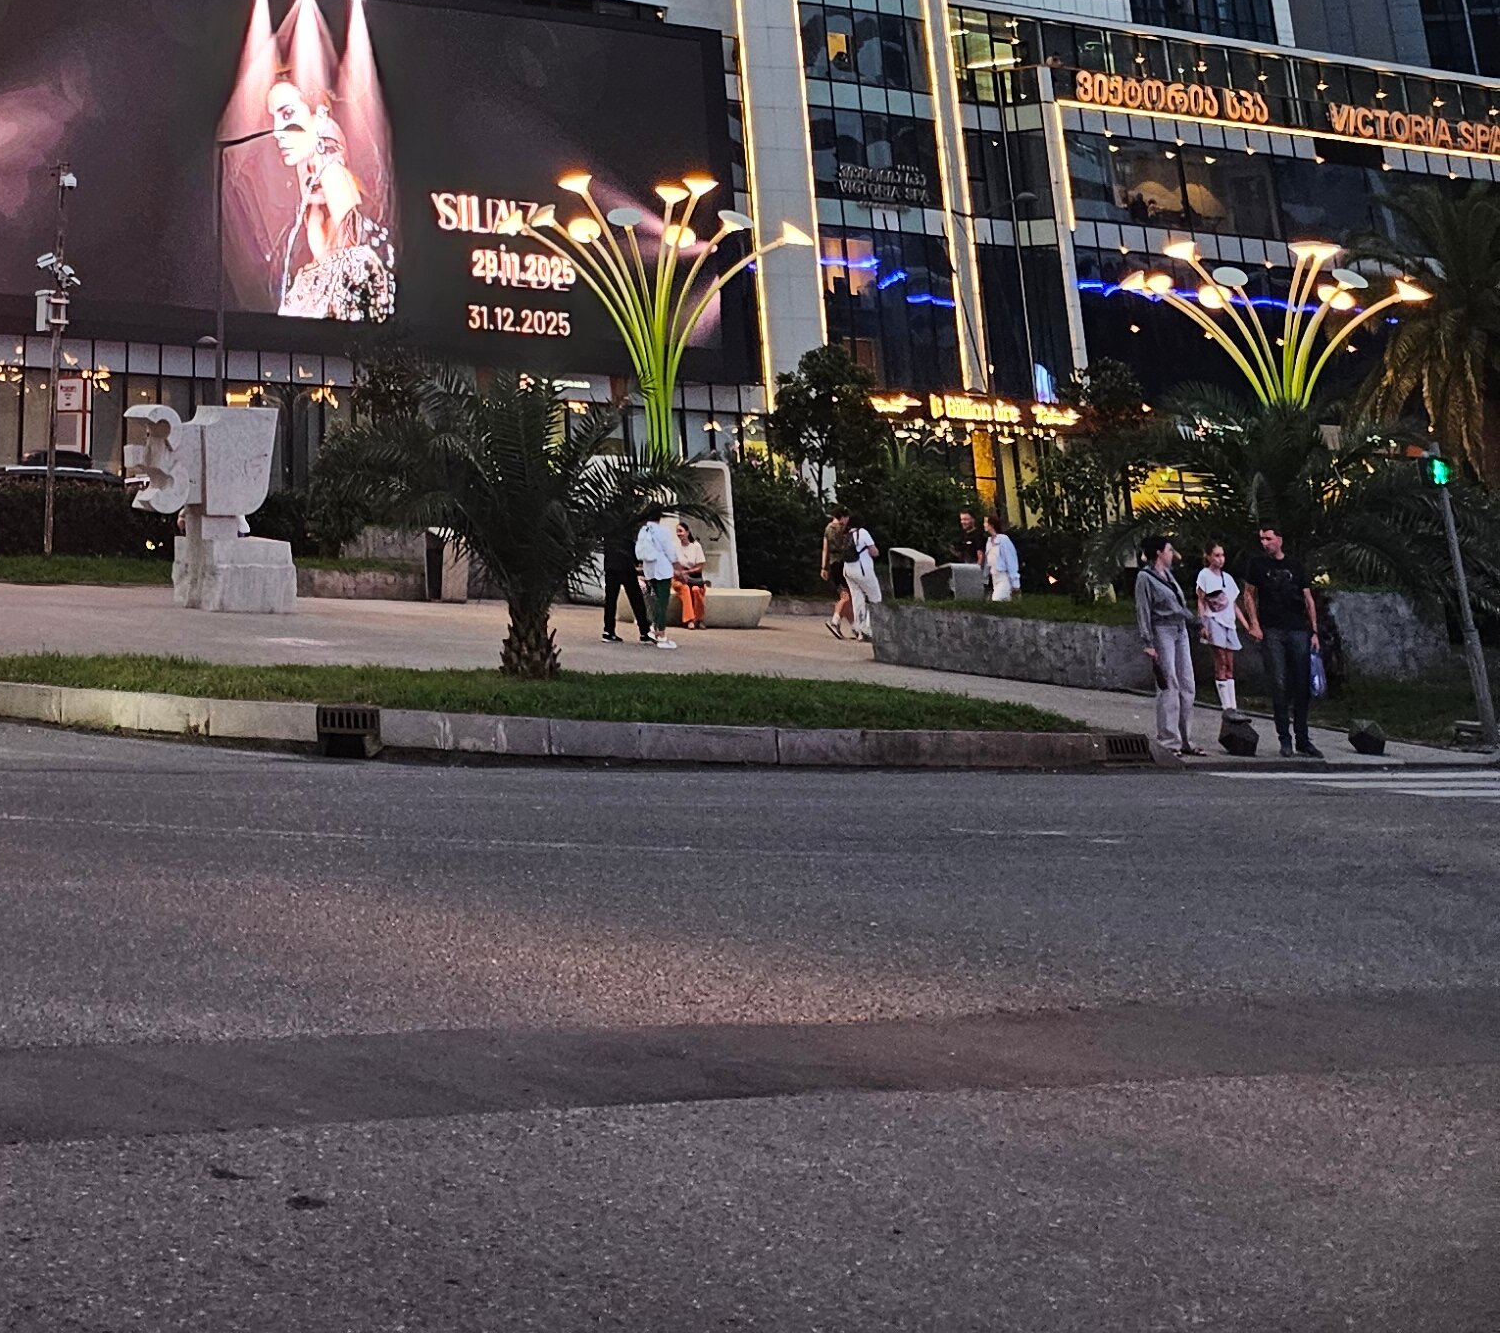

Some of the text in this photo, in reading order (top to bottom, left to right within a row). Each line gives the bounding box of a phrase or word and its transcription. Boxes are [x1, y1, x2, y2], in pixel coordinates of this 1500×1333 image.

[1075, 69, 1219, 117] ვიქტორია
[1328, 101, 1453, 149] VICTORIA
[839, 179, 901, 199] VICTORIA
[467, 304, 572, 337] 31.12.2025
